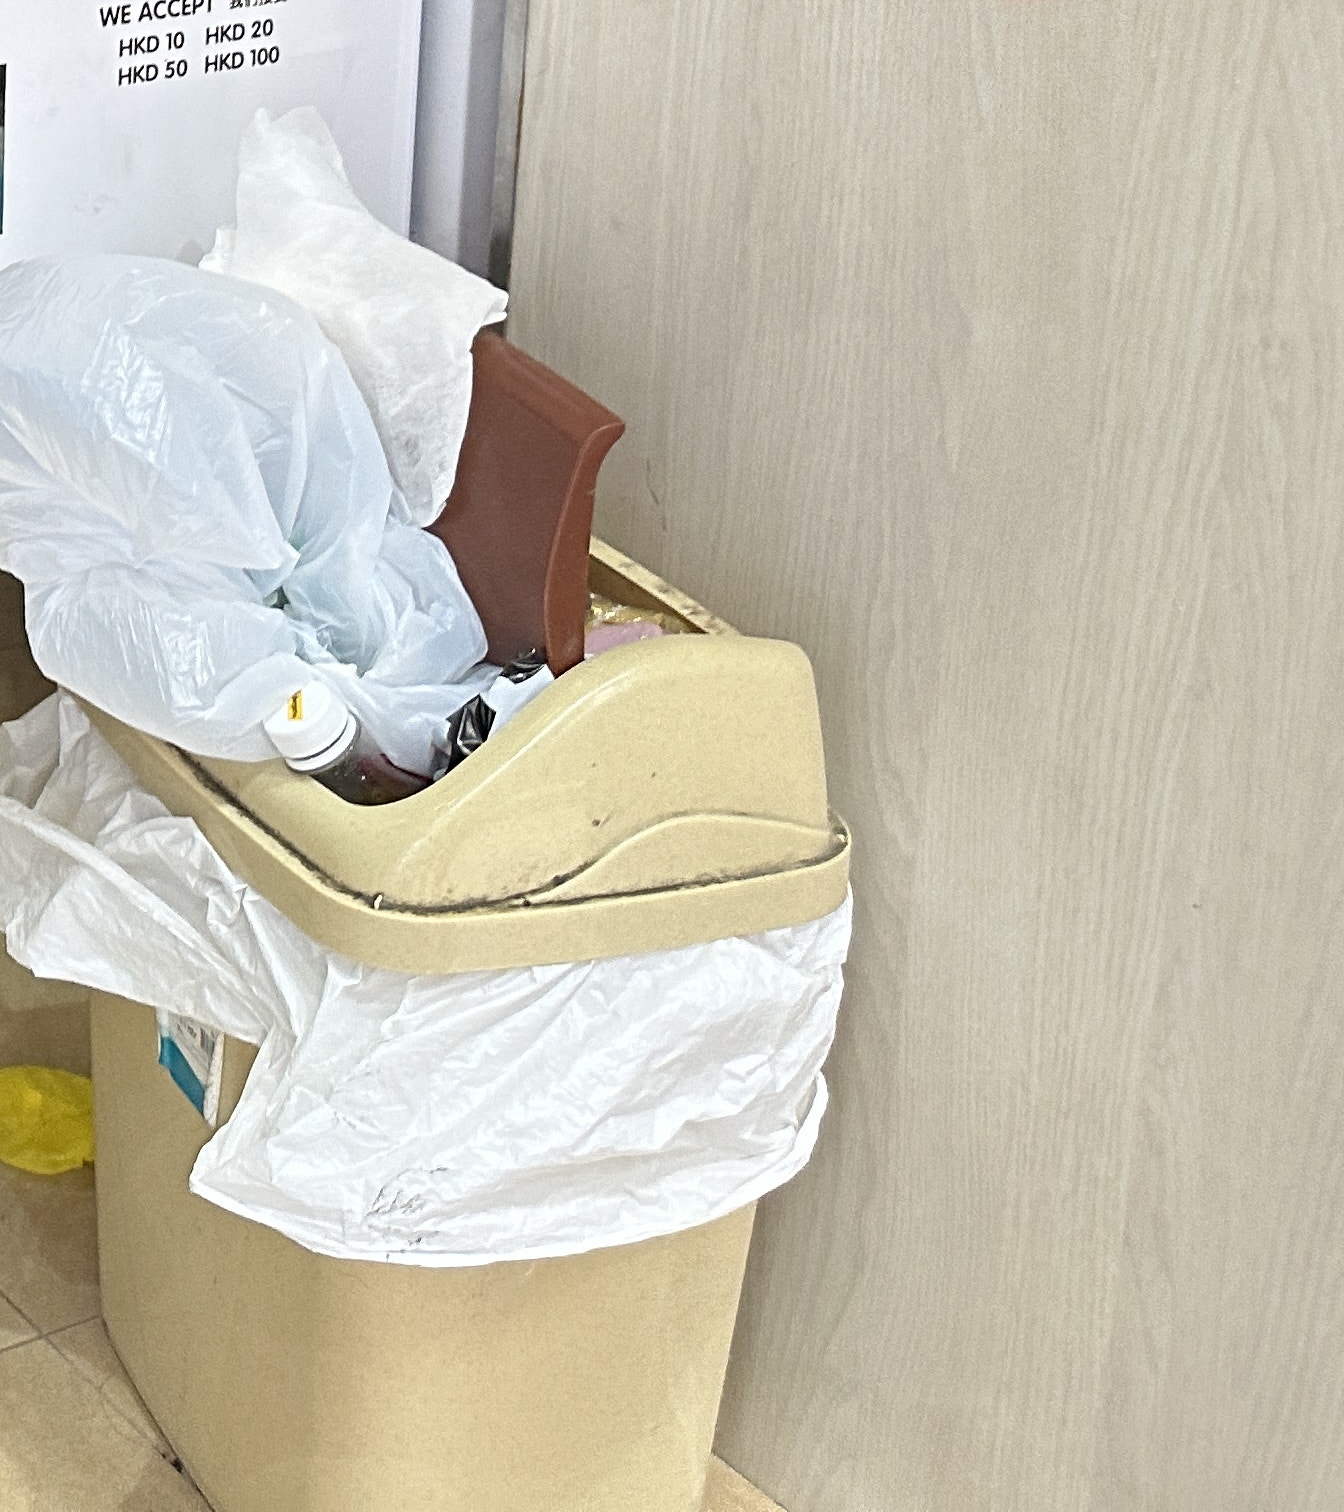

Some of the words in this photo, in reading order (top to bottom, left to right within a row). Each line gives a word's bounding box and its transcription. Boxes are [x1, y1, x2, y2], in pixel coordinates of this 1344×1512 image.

[100, 3, 132, 27] WE
[119, 35, 160, 58] HKD
[166, 31, 185, 51] 10
[205, 23, 245, 46] HKD
[251, 18, 274, 39] 20
[118, 64, 159, 87] HKD
[164, 59, 188, 79] 50
[204, 51, 244, 74] HKD
[250, 46, 280, 68] 100
